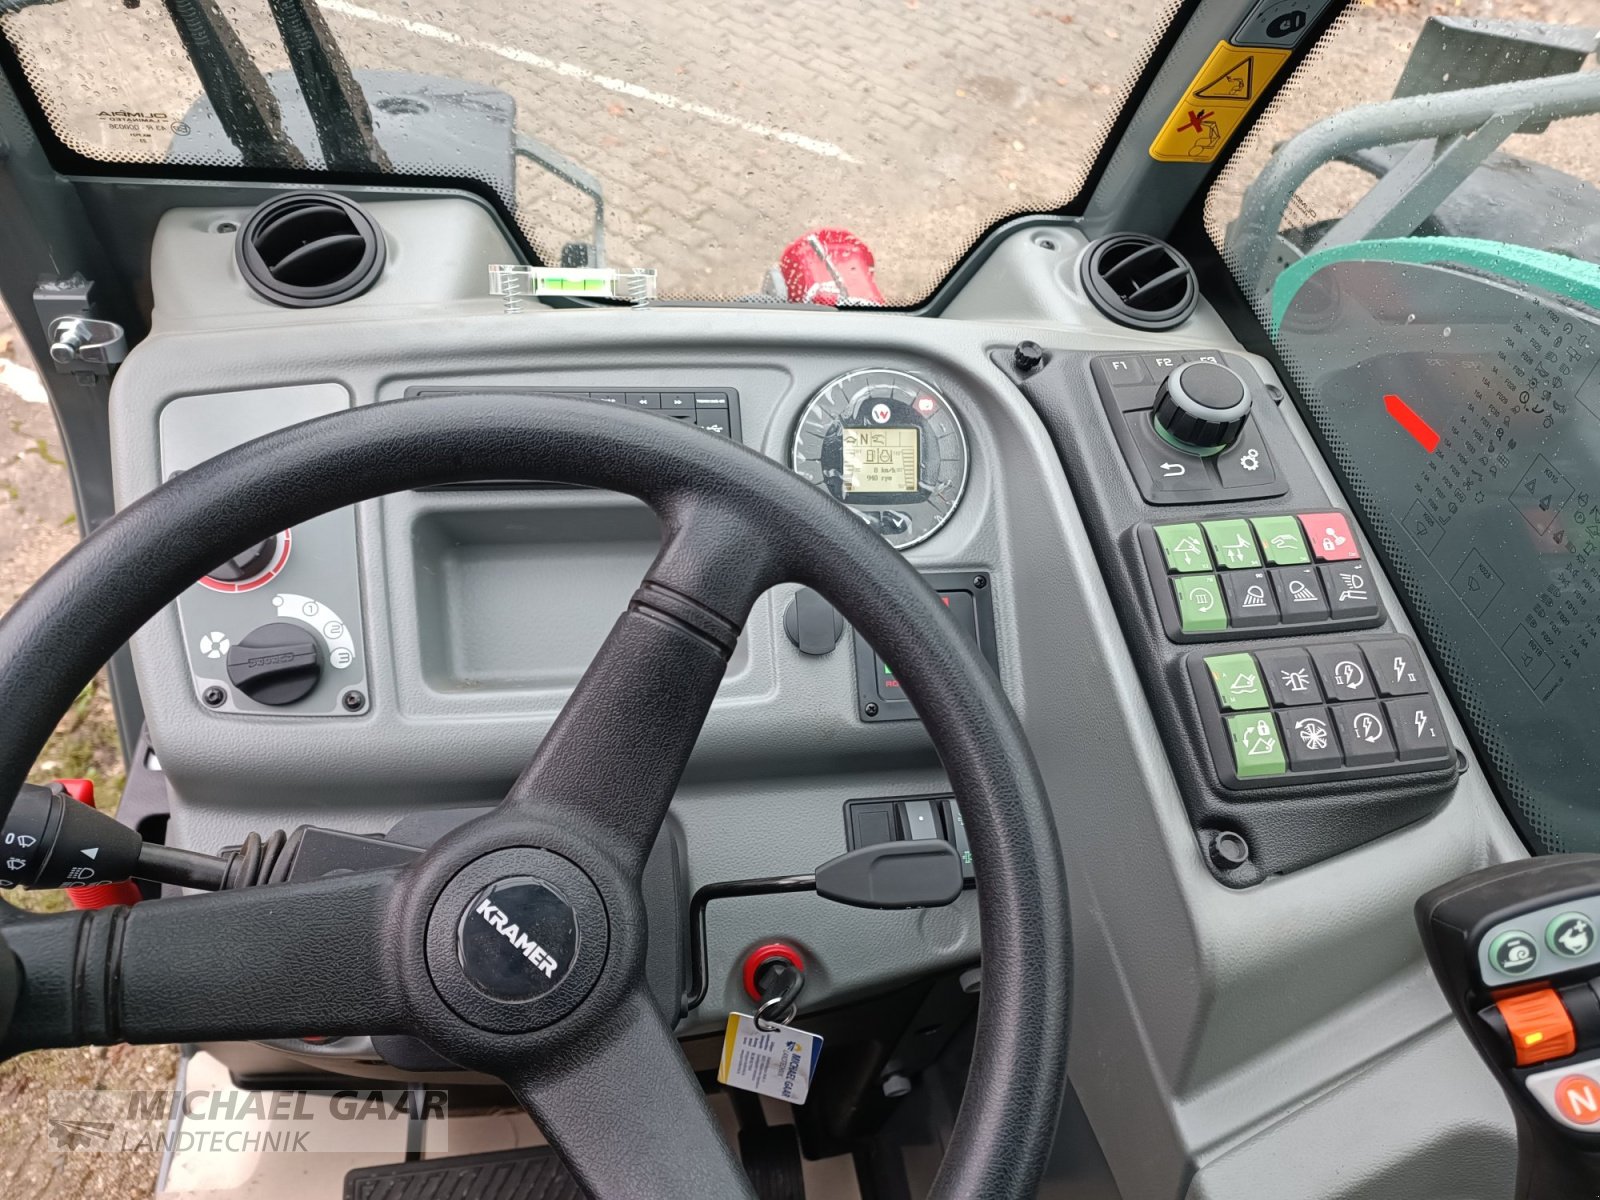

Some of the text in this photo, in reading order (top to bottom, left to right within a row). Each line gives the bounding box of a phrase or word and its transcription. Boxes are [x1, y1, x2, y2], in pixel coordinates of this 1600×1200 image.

[1546, 310, 1560, 324] F023
[1538, 324, 1552, 337] F024
[1112, 361, 1127, 370] F1
[1156, 358, 1173, 367] F2
[860, 434, 868, 444] N
[1543, 468, 1559, 484] K010
[1582, 578, 1596, 593] F017
[1565, 600, 1579, 616] F019
[1557, 610, 1570, 626] F020
[1549, 620, 1562, 636] F021
[476, 898, 559, 979] KRAMER
[784, 1054, 800, 1080] MICHAEL
[1566, 1085, 1596, 1116] N
